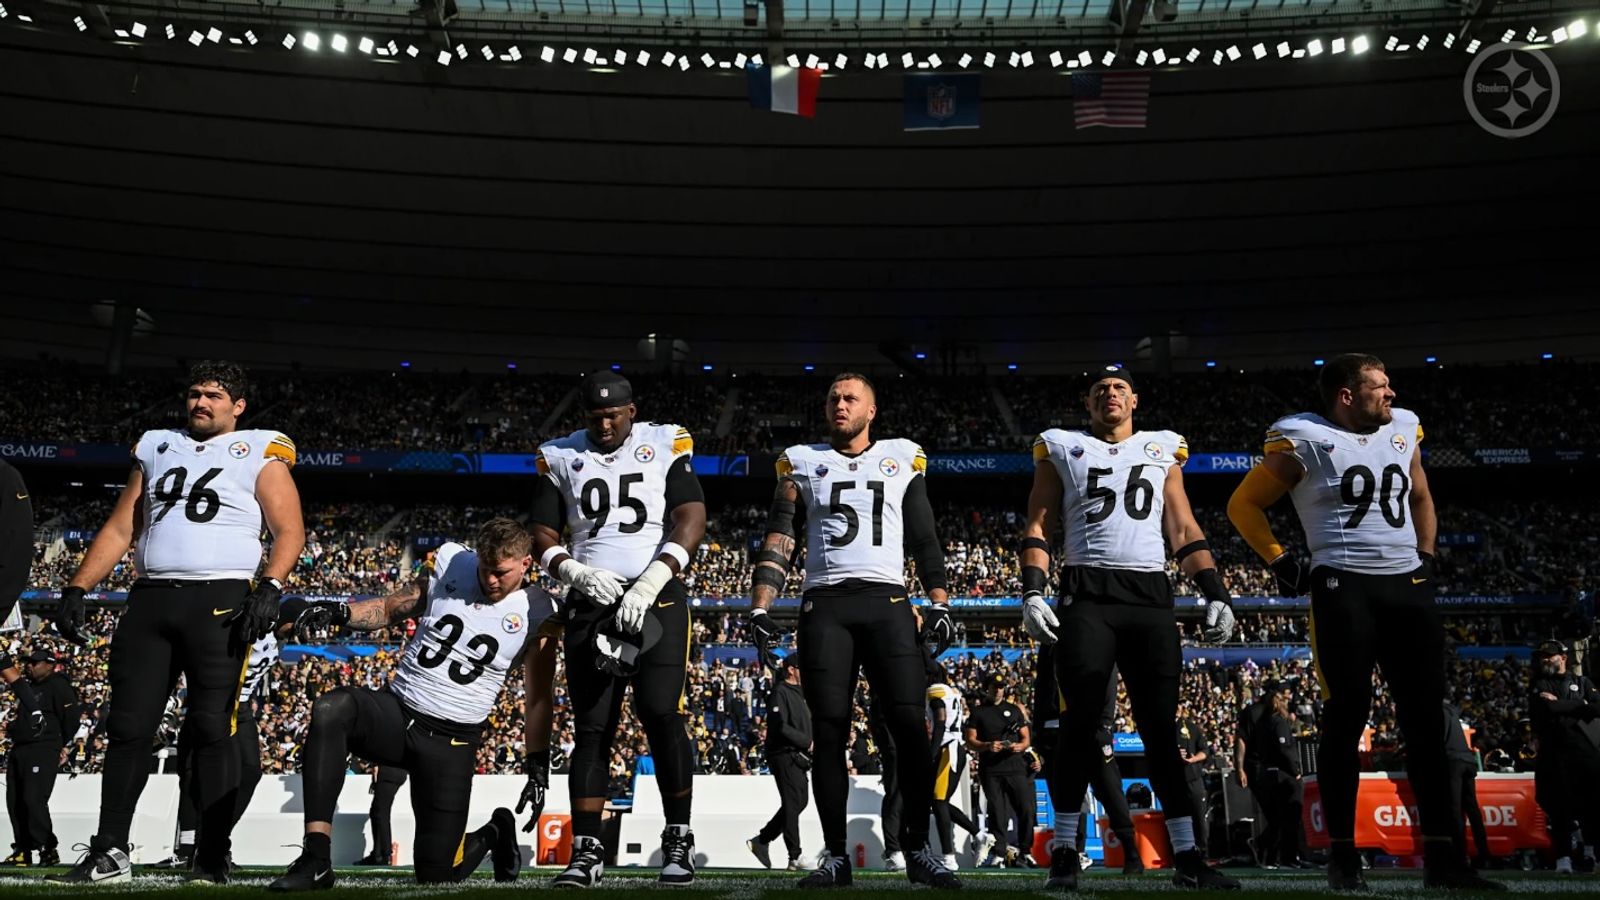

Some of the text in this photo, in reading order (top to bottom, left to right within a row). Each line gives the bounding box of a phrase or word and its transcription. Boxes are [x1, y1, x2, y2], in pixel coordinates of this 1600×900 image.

[930, 99, 954, 114] NFL
[0, 444, 57, 458] GAME
[1482, 456, 1532, 464] EXPRESS
[938, 458, 996, 472] FRANCE
[1211, 456, 1264, 469] PARIS
[152, 466, 224, 524] 96
[1085, 464, 1154, 524] 56
[1340, 463, 1409, 529] 90
[580, 472, 648, 540] 95
[829, 480, 885, 547] 51
[963, 598, 1001, 606] FRANCE
[1473, 596, 1515, 604] FRANCE
[417, 613, 499, 685] 33
[1310, 801, 1323, 833] G
[1374, 805, 1518, 828] GATDE
[543, 819, 562, 841] G
